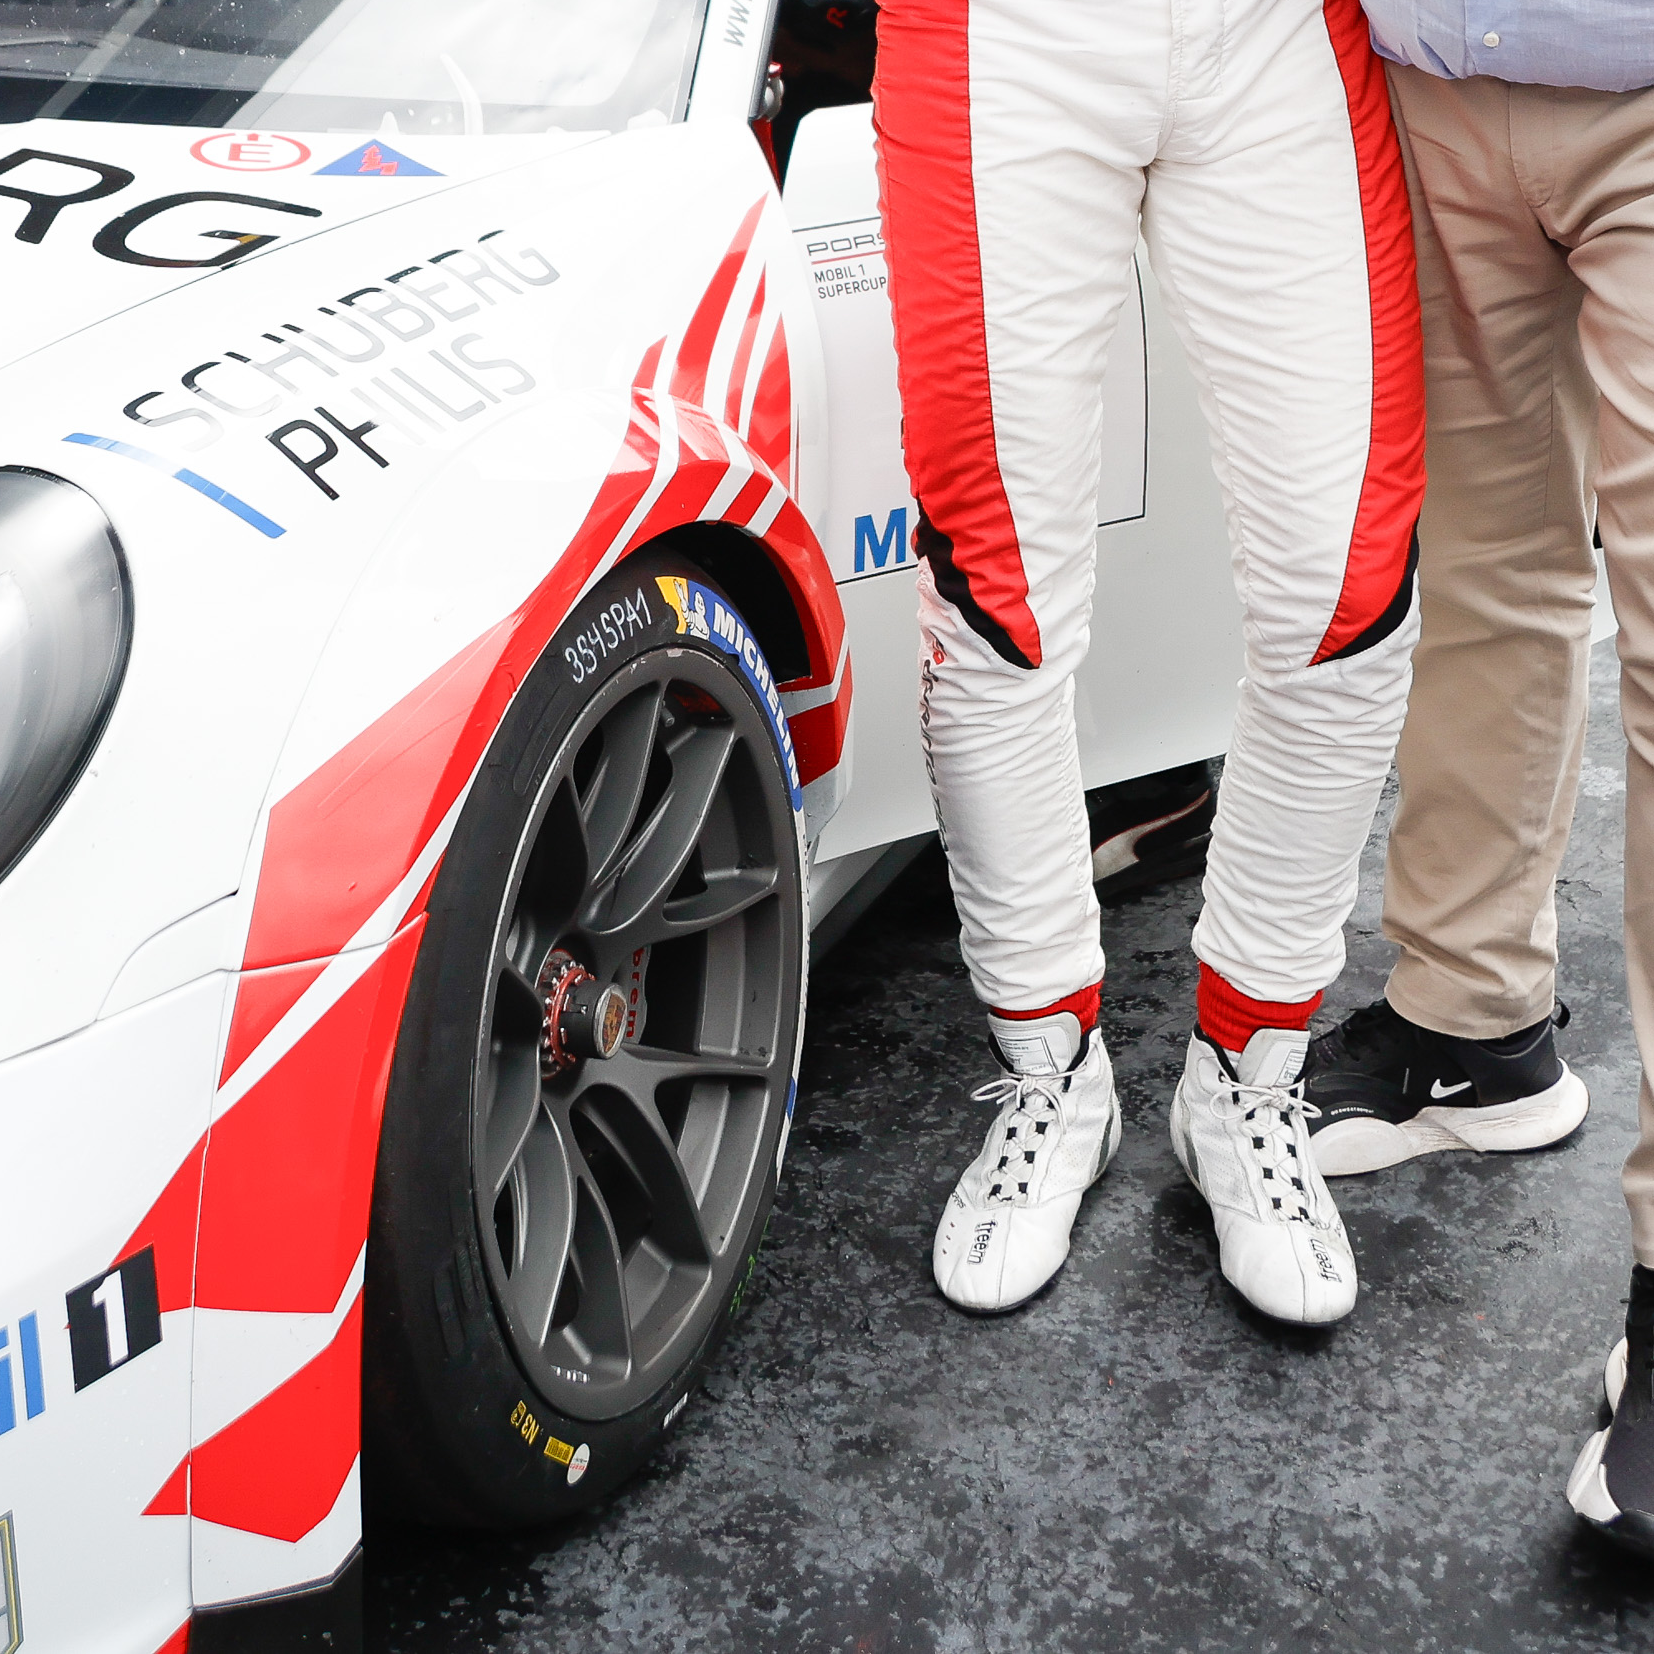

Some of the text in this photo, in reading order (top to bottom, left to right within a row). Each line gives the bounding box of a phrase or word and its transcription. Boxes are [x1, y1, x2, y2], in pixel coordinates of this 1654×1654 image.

[814, 264, 866, 284] MOBIL 1
[817, 276, 887, 300] SUPERCUP
[122, 229, 561, 454] SCHUBERG
[265, 331, 537, 502] PHILIS
[712, 601, 801, 790] MICHELIN
[966, 1219, 999, 1266] freem
[1310, 1238, 1343, 1283] freem
